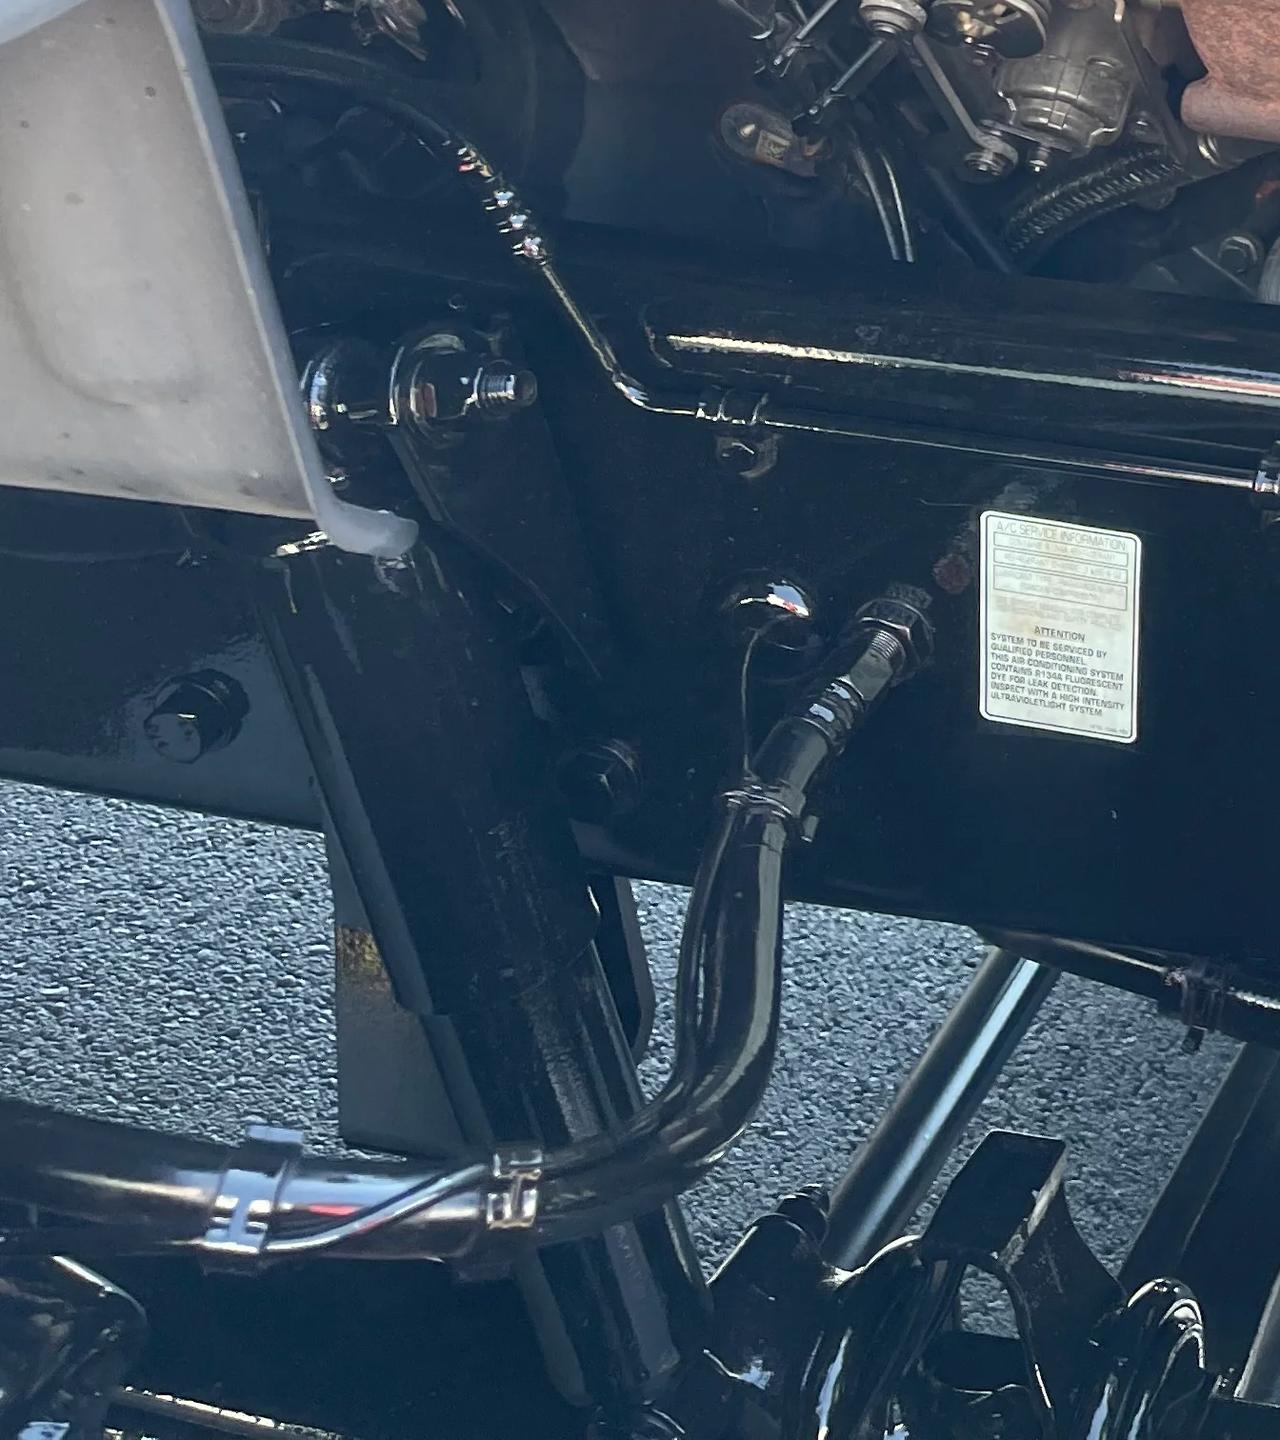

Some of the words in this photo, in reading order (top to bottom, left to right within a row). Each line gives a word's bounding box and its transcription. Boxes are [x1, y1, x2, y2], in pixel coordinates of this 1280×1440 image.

[996, 520, 1016, 533] A/C
[1019, 524, 1055, 539] SERVICE
[1060, 530, 1125, 550] INFORMATION
[991, 632, 1024, 645] SYSTEM
[1027, 638, 1036, 647] TO
[1040, 640, 1049, 649] BE
[1053, 642, 1093, 656] SERVICED
[1096, 649, 1107, 659] BY
[1034, 625, 1086, 642] ATTENTION
[991, 642, 1032, 656] QUALIFIED
[991, 652, 1008, 662] THIS
[1011, 656, 1024, 665] AIR
[1028, 658, 1086, 675] CONDITIONING
[1089, 669, 1123, 681] SYSTEM
[991, 662, 1031, 675] CONTAINS
[1035, 669, 1062, 680] R134A
[1065, 674, 1122, 691] FLUORESCENT
[991, 672, 1006, 681] DYE
[1010, 675, 1025, 684] FOR
[1028, 678, 1047, 688] LEAK
[991, 681, 1024, 694] INSPECT
[1028, 687, 1048, 698] WITH
[1059, 693, 1079, 702] HIGH
[1082, 697, 1124, 710] INTENSITY
[1069, 704, 1101, 716] SYSTEM
